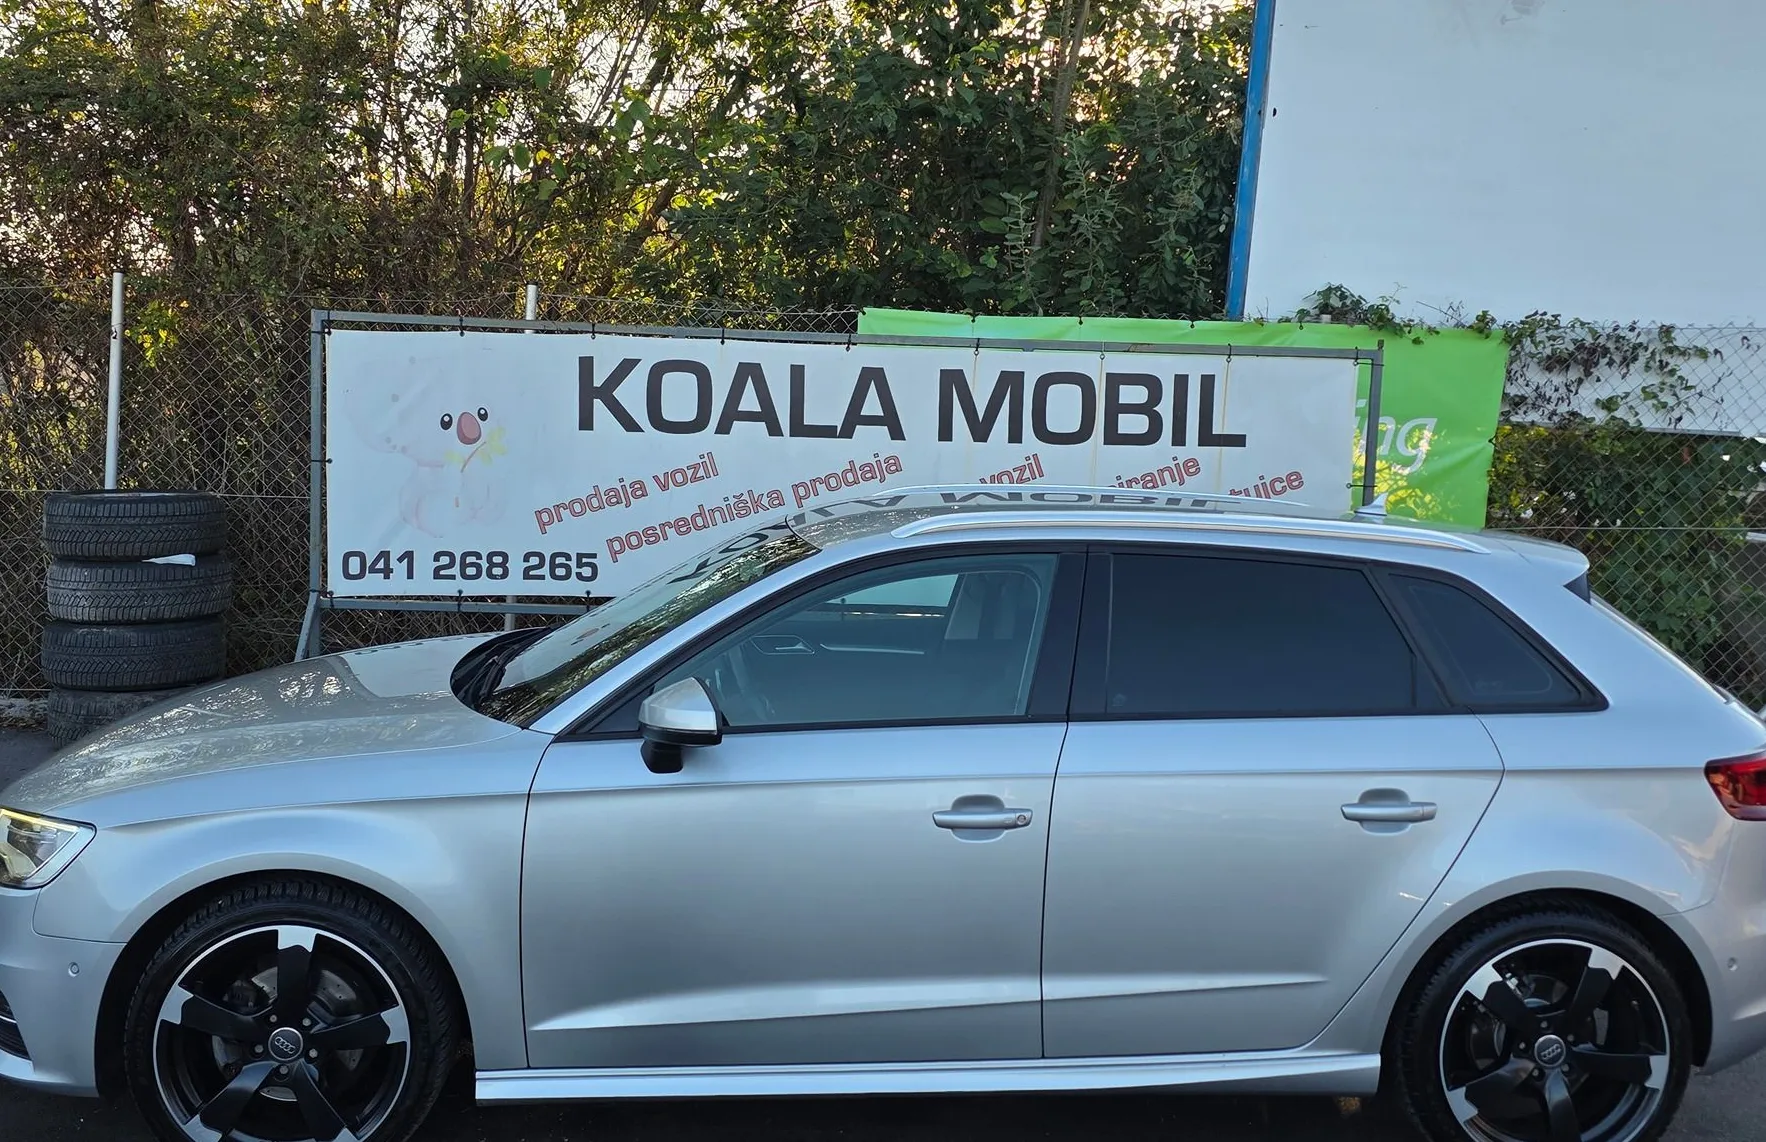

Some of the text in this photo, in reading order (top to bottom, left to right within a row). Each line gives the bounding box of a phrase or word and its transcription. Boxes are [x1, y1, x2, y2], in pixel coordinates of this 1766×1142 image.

[577, 355, 1247, 448] KOALA MOBIL
[534, 451, 719, 535] prodaja vozil
[606, 452, 903, 563] posredniška prodaja
[1107, 455, 1201, 490] iranje
[342, 550, 599, 582] 041 268 265
